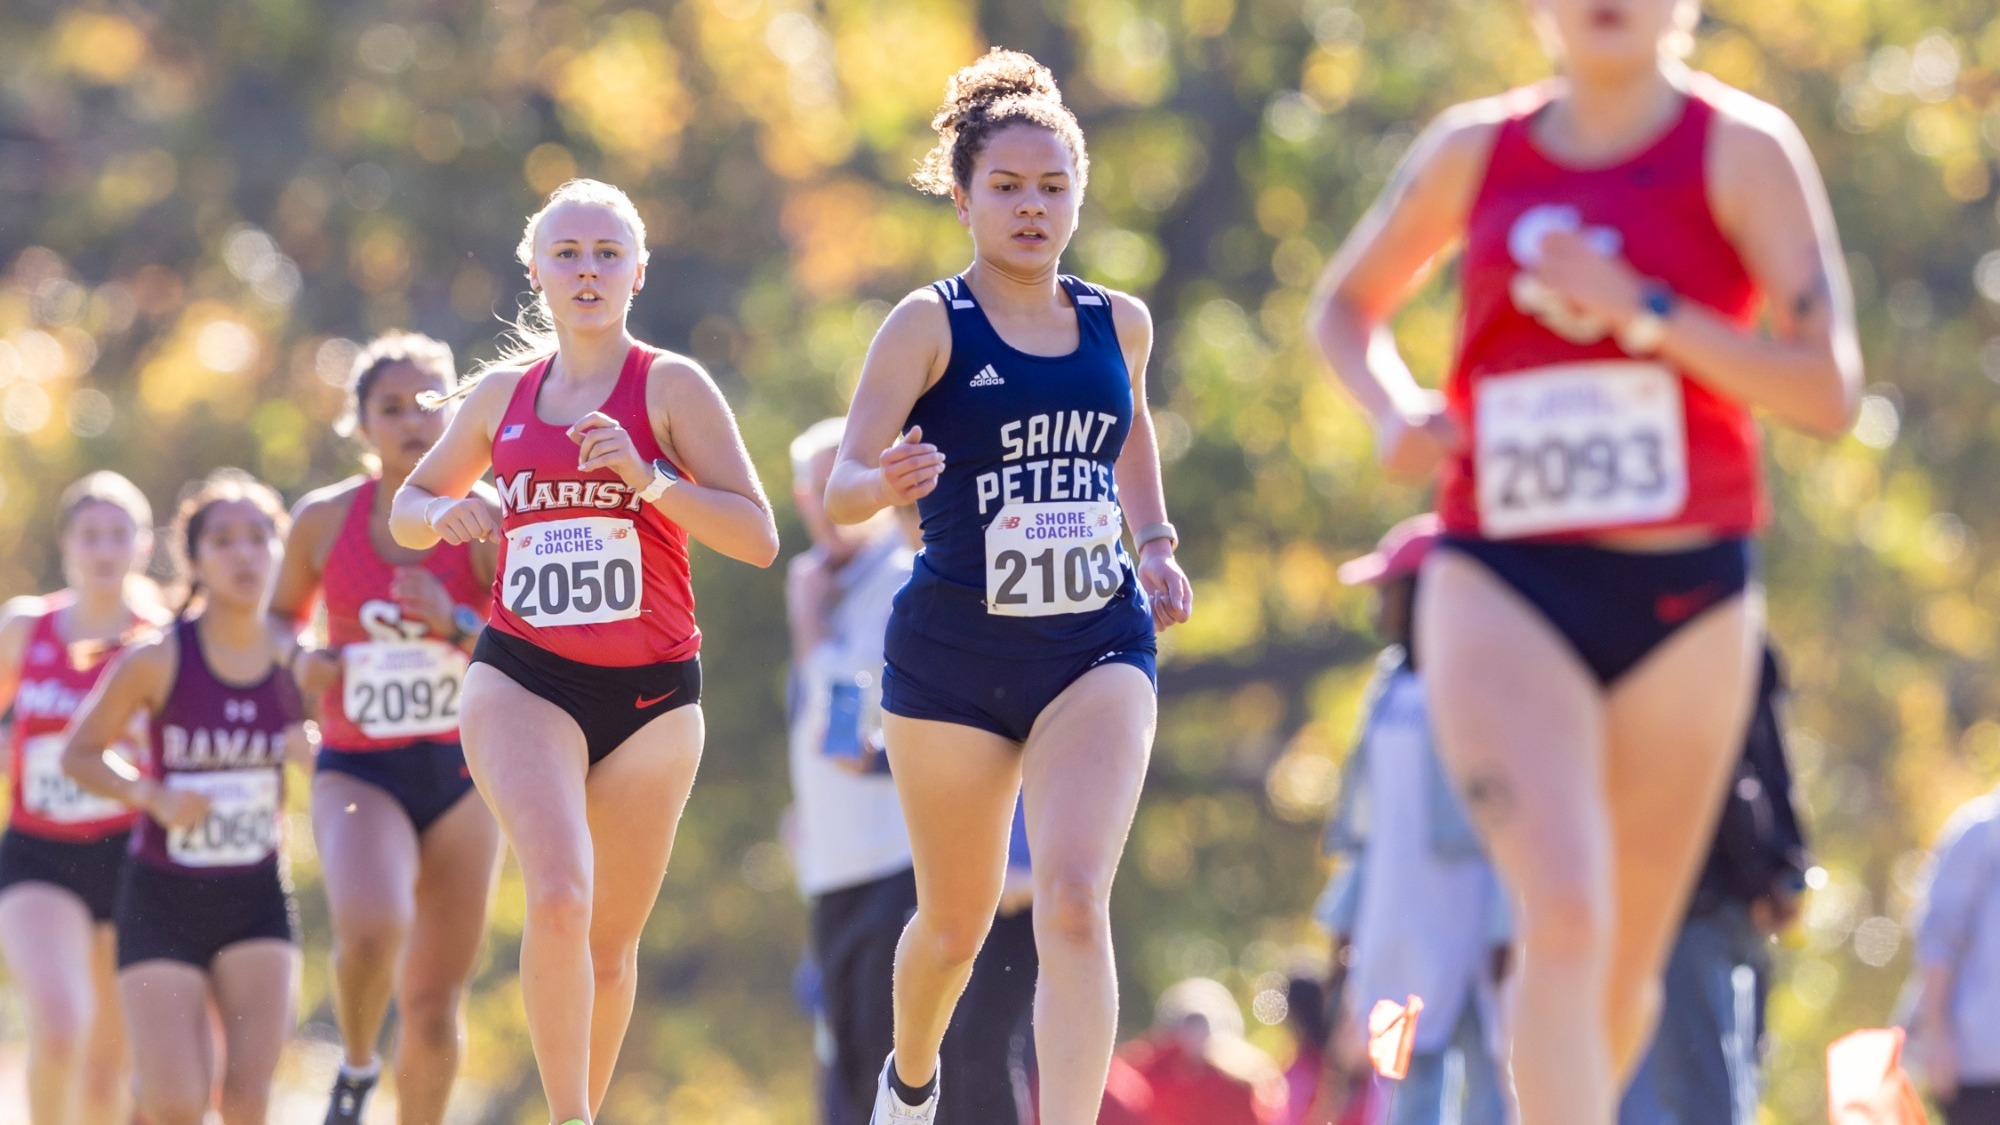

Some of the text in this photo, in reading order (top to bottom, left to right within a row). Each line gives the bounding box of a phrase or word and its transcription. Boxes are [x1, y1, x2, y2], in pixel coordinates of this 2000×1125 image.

[969, 375, 1005, 388] adidas
[1000, 409, 1118, 462] SAINT
[976, 457, 1111, 515] PETER'S
[1495, 425, 1669, 511] 2093
[544, 526, 593, 542] SHORE
[1025, 525, 1094, 540] COACHES
[1035, 511, 1086, 526] SHORE
[535, 538, 604, 556] COACHES
[510, 558, 636, 618] 2050
[994, 543, 1119, 605] 2103
[354, 675, 460, 725] 2092
